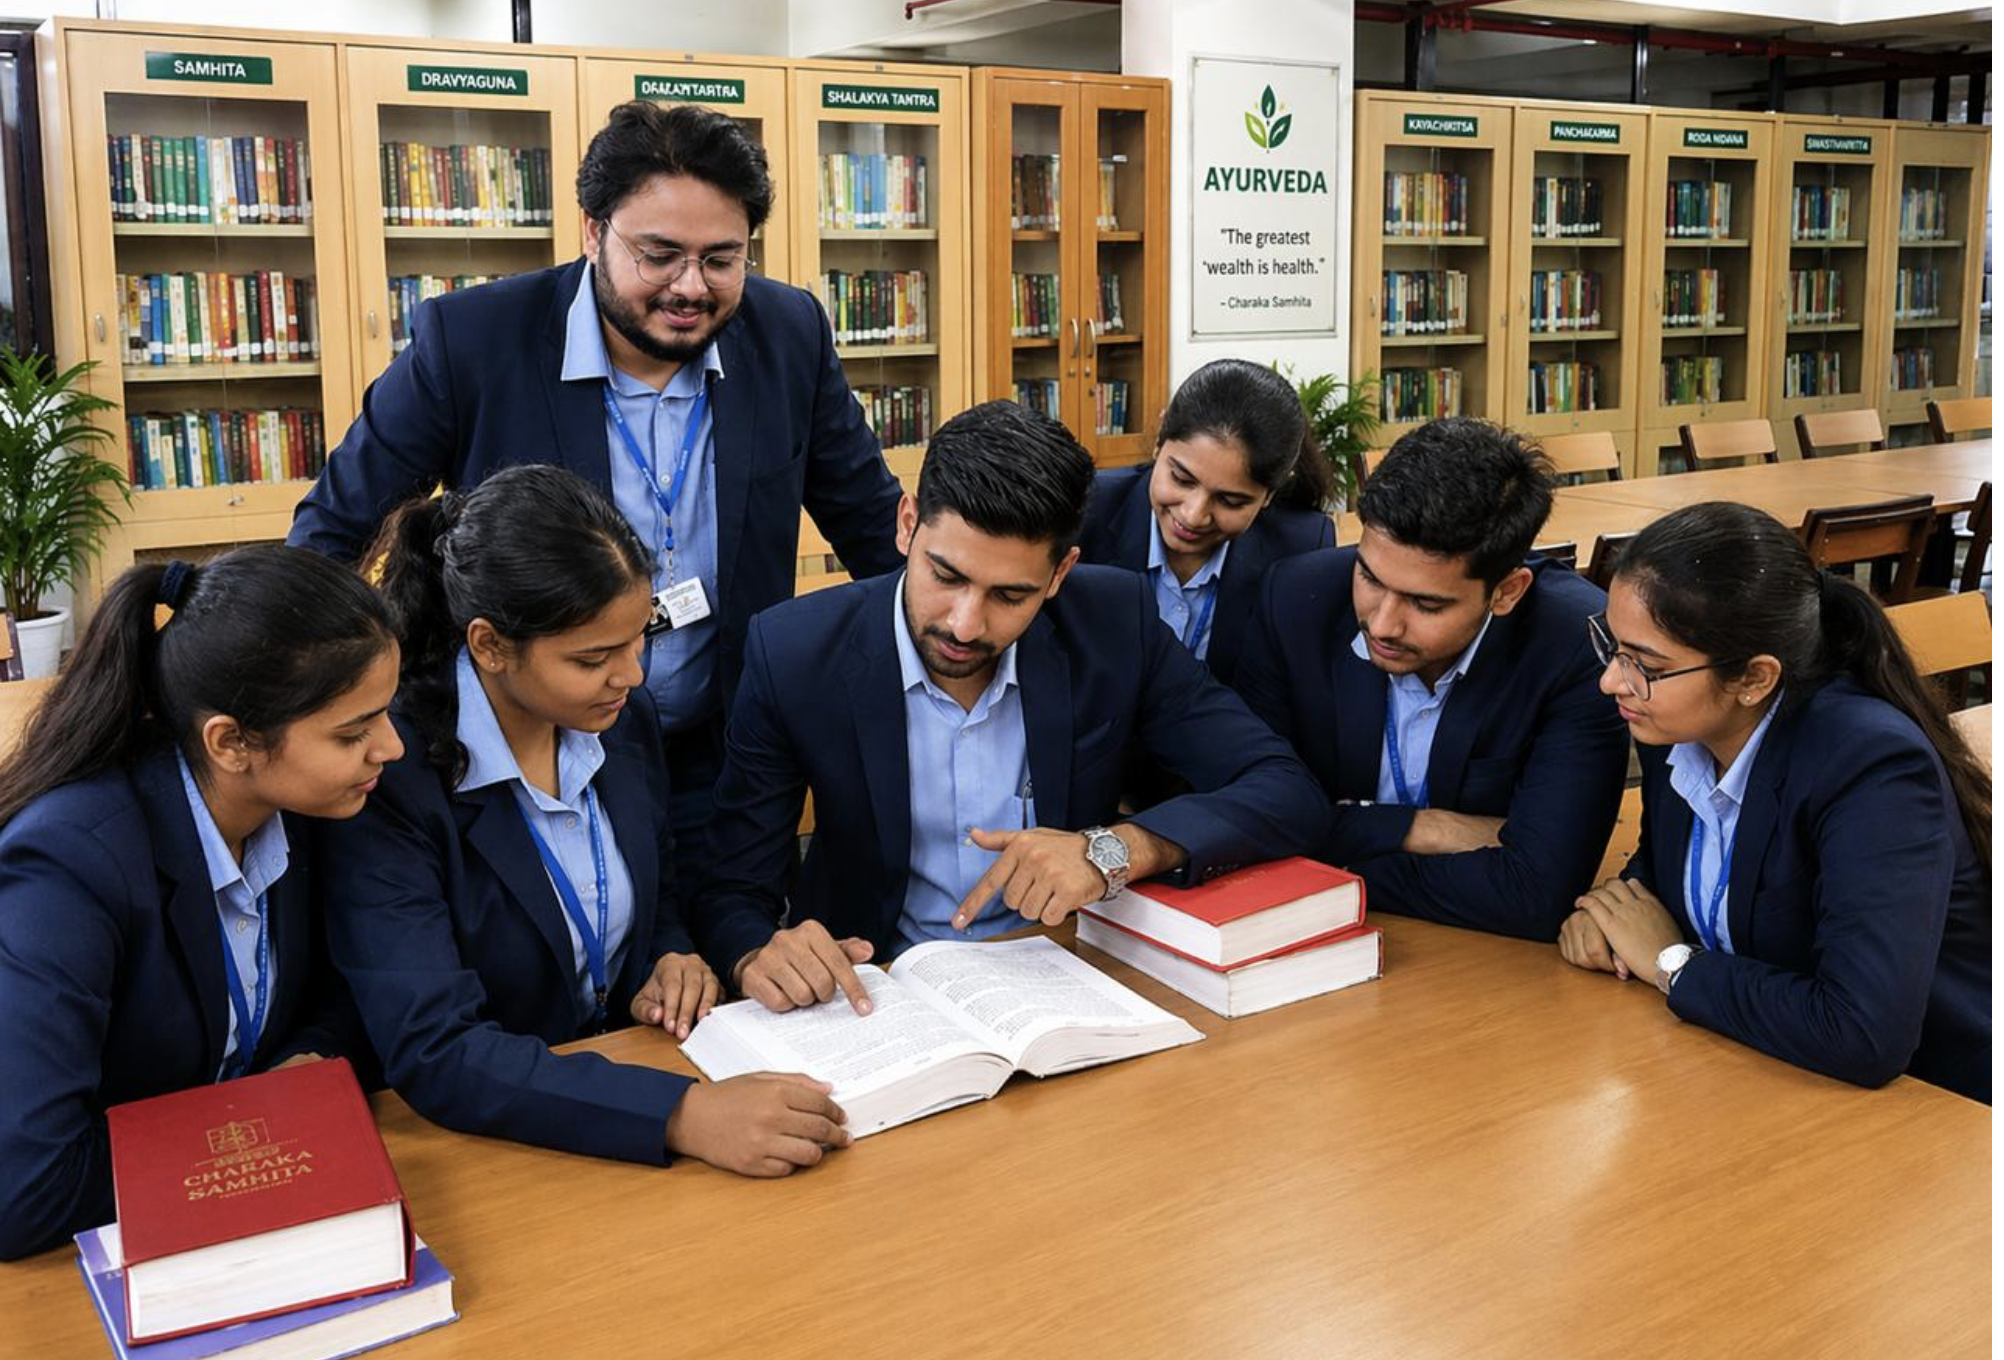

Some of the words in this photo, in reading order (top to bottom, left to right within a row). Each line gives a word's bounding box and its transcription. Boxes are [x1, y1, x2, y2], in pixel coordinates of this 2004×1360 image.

[174, 59, 247, 78] SAMHITA
[421, 72, 517, 90] DRAVYAGUNA
[827, 90, 889, 106] SHALAKYA
[1203, 166, 1328, 194] AYURVEDA
[1255, 230, 1311, 249] greatest
[1257, 258, 1269, 275] is
[1227, 296, 1270, 309] Charaka
[1272, 295, 1312, 308] Samhita
[183, 1150, 313, 1187] CHARAKA
[188, 1164, 313, 1201] SAMHITA
